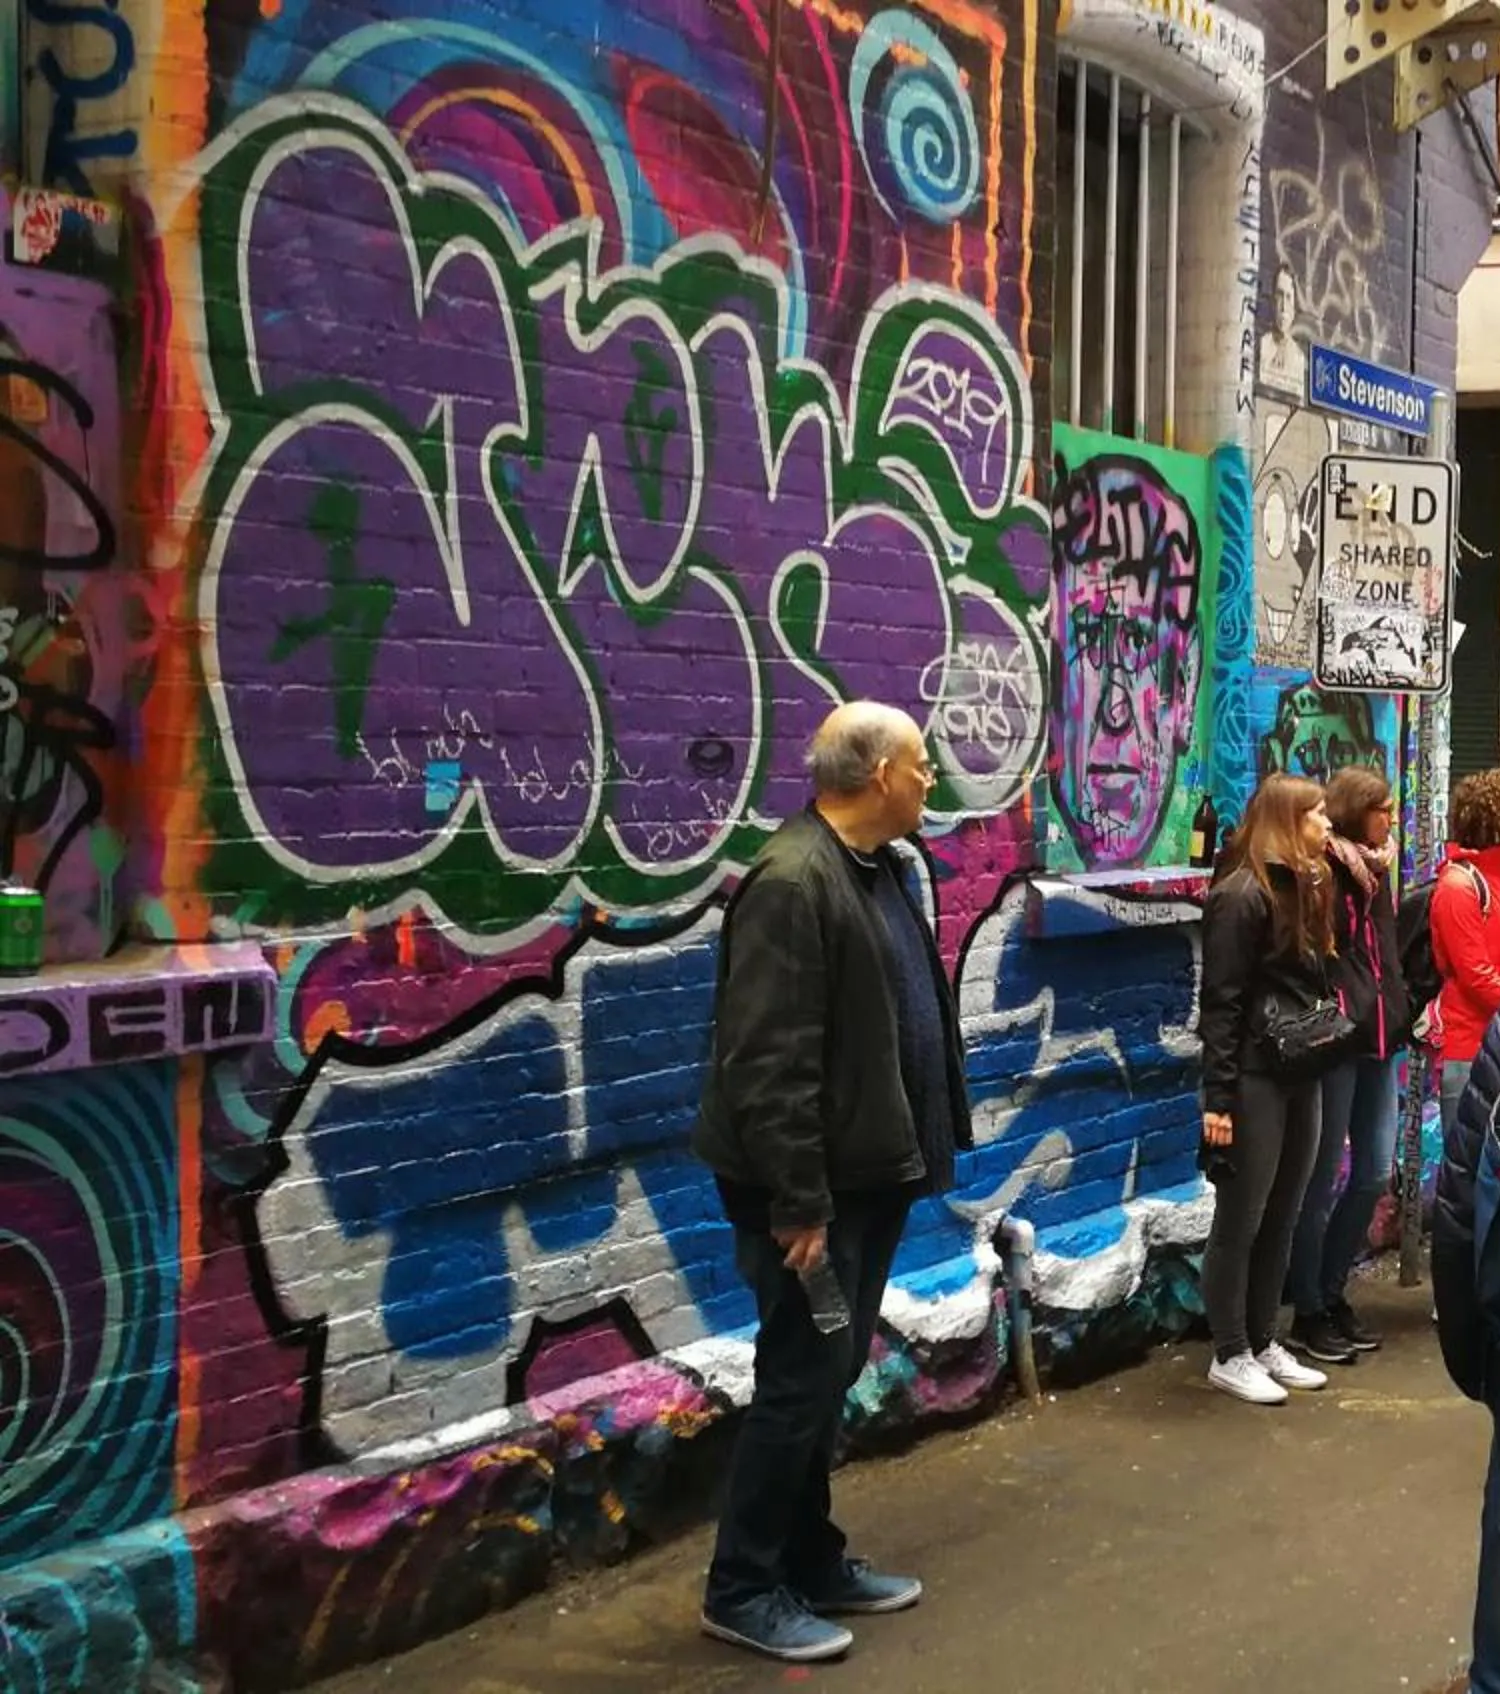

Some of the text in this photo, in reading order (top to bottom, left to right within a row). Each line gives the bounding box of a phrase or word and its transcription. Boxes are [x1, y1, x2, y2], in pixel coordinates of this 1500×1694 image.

[1338, 363, 1427, 422] Stevenson
[1335, 481, 1438, 526] END
[1339, 542, 1432, 568] SHARED
[1354, 579, 1413, 601] ZONE
